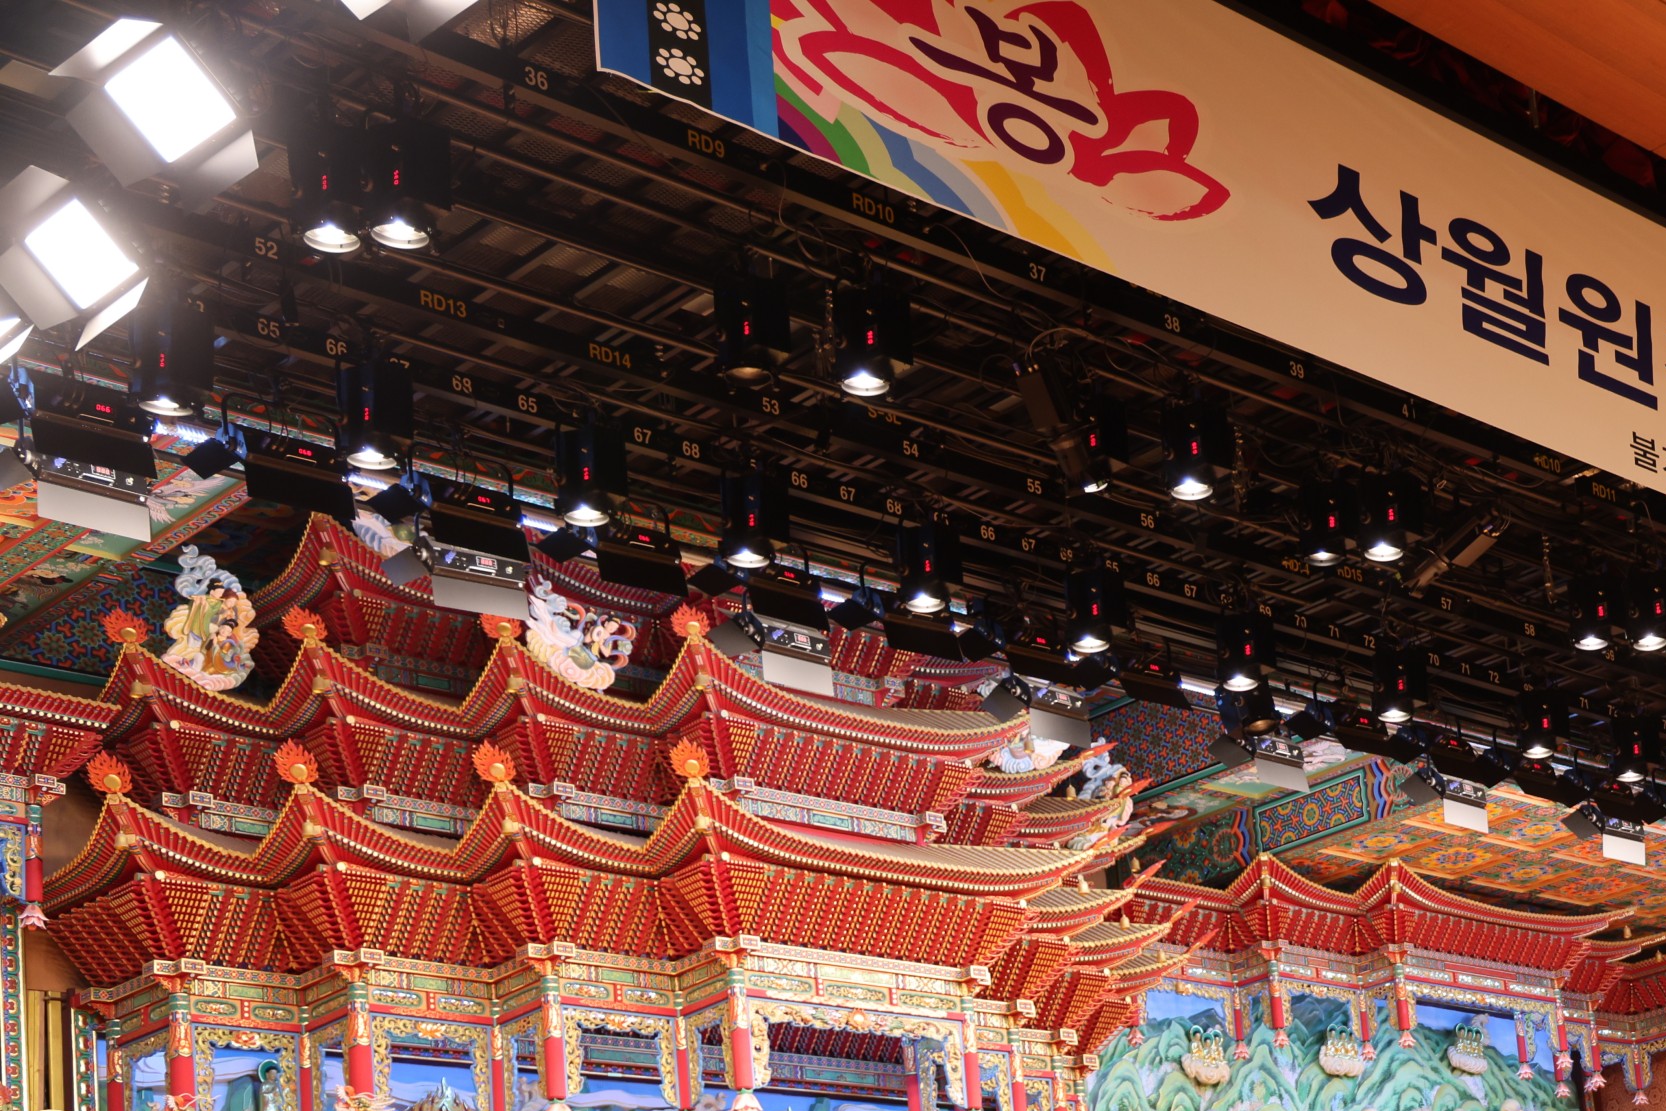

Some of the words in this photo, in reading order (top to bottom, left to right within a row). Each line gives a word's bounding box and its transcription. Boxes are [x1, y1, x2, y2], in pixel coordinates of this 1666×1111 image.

[524, 66, 549, 91] 36
[908, 5, 1100, 165] 봉
[687, 129, 727, 159] RD9
[851, 192, 895, 225] RD10
[254, 237, 279, 260] 52
[1028, 262, 1047, 283] 37
[419, 289, 468, 319] RD13
[256, 318, 280, 338] 65
[1163, 313, 1182, 334] 38
[325, 338, 347, 357] 66
[588, 342, 632, 370] RD14
[1289, 360, 1305, 380] 39
[517, 394, 538, 414] 65
[761, 397, 781, 416] 53
[633, 426, 653, 445] 67
[682, 440, 701, 459] 68
[902, 438, 920, 459] 54
[791, 470, 809, 489] 66
[1026, 478, 1044, 495] 55
[839, 484, 857, 503] 67
[1591, 480, 1617, 504] RD11
[886, 498, 903, 517] 68
[1140, 513, 1155, 529] 56
[980, 524, 997, 541] 66
[1021, 537, 1037, 554] 67
[1145, 571, 1161, 588] 66
[1183, 583, 1198, 599] 67
[1440, 596, 1454, 612] 57
[1523, 622, 1536, 638] 58
[1362, 634, 1377, 649] 72
[1428, 652, 1441, 668] 70
[1488, 669, 1502, 684] 72
